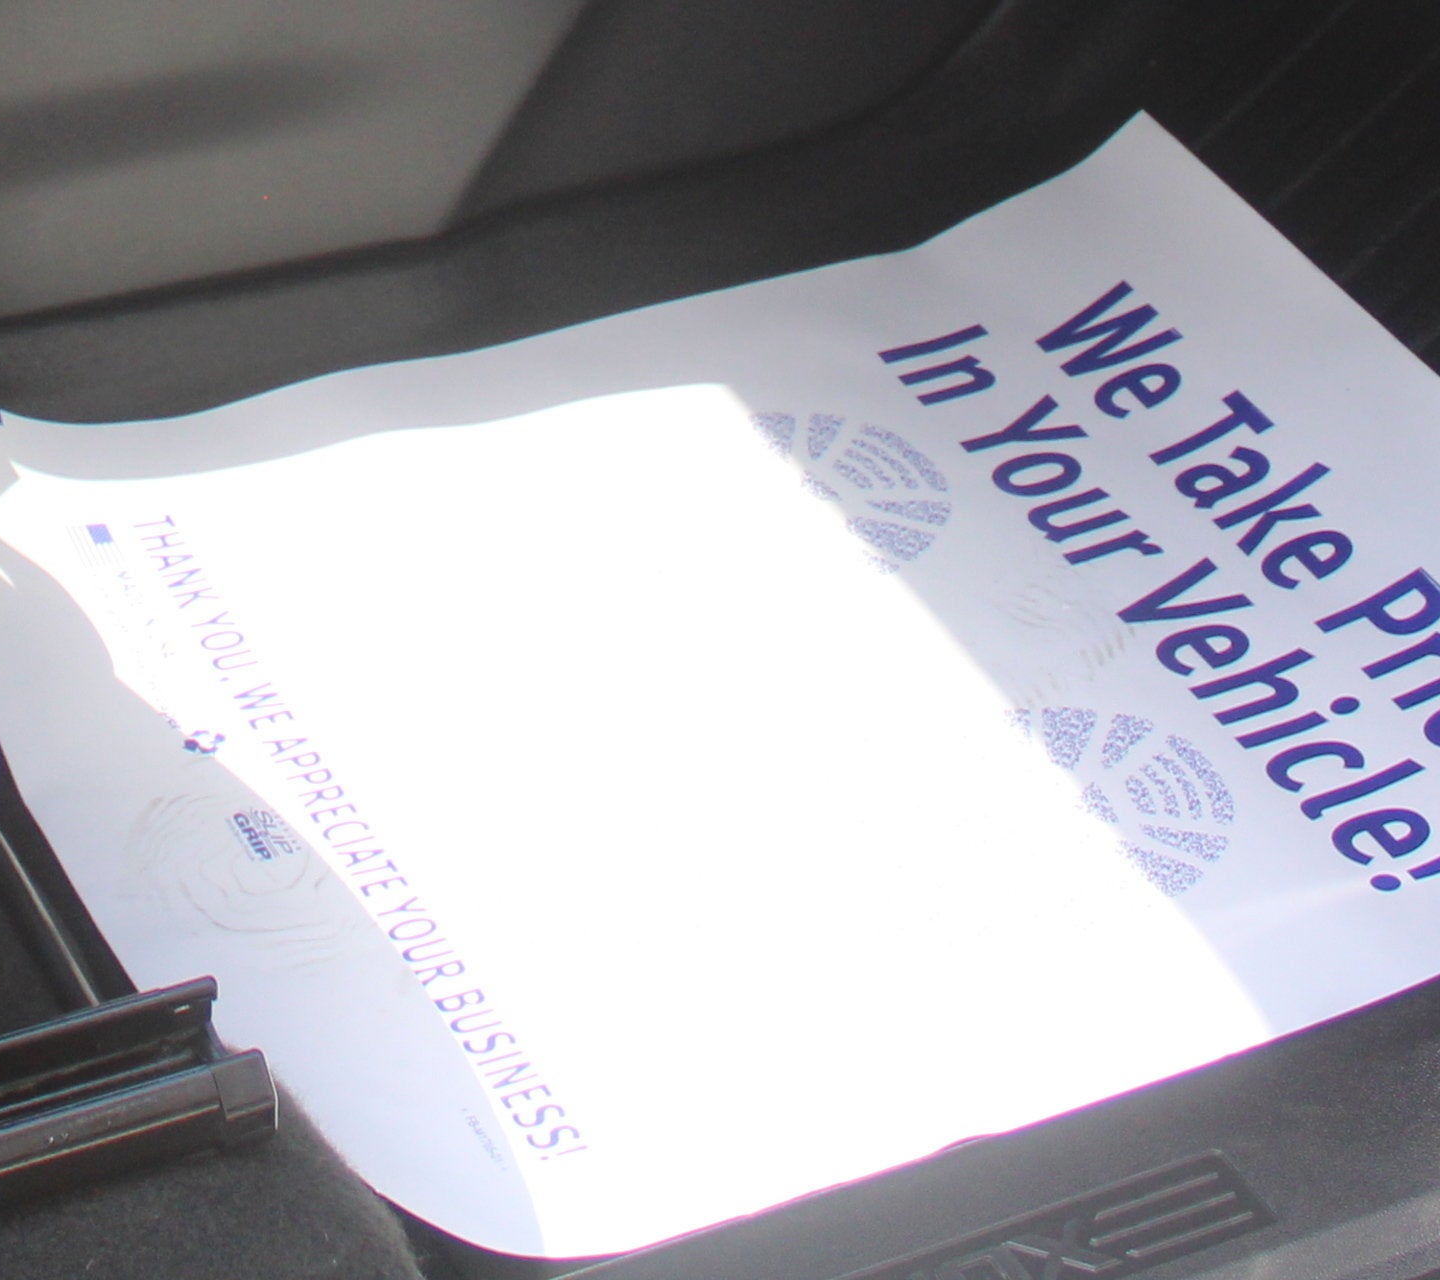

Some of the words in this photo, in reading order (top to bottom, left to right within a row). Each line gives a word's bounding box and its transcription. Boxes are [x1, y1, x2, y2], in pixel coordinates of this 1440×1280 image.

[877, 323, 997, 406] In
[959, 393, 1163, 565] Your
[1034, 279, 1183, 419] We
[1149, 389, 1353, 590] Take
[133, 515, 219, 609] THANK
[233, 682, 294, 730] WE
[233, 812, 272, 860] GRIP
[262, 738, 408, 897] APPRECIATE
[377, 896, 465, 986] YOUR
[432, 988, 588, 1160] BUSINESS!
